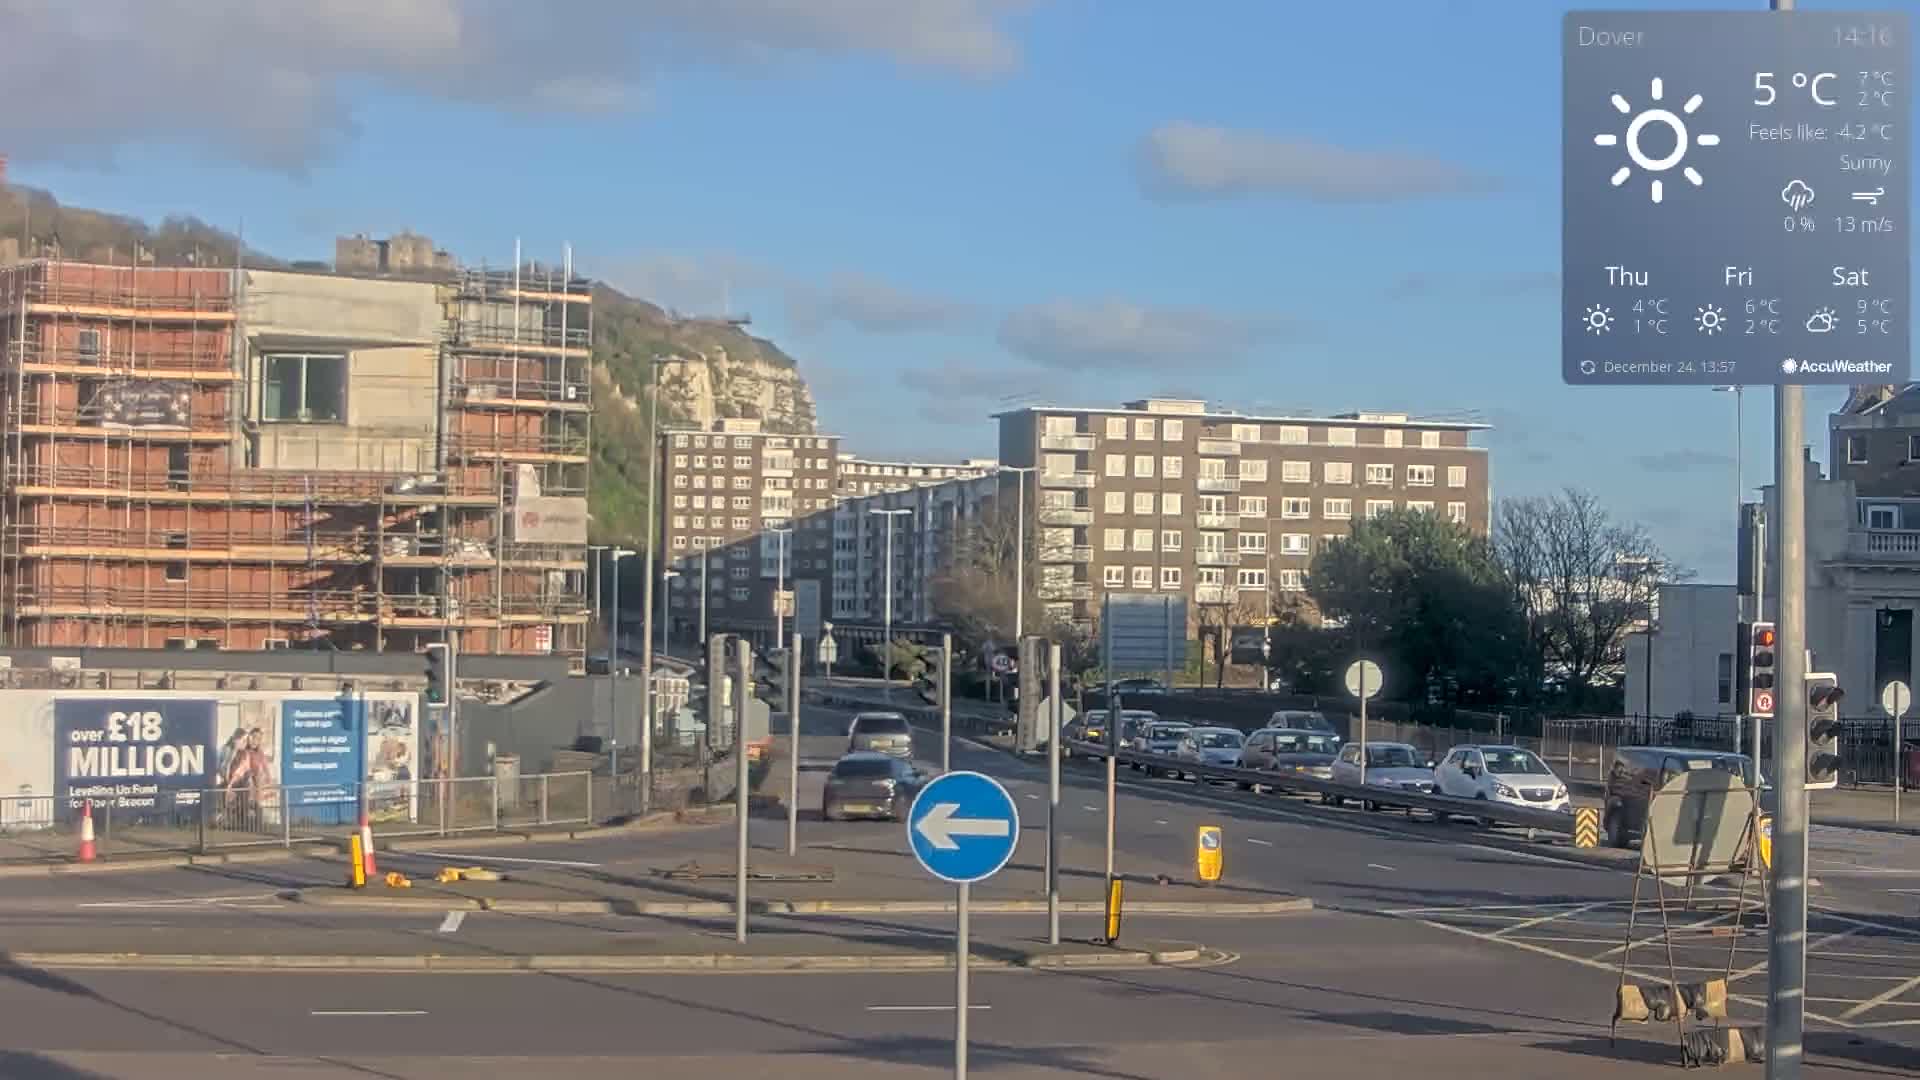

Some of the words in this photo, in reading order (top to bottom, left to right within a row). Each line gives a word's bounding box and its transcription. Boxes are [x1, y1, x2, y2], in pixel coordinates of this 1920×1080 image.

[71, 730, 104, 742] over
[109, 711, 162, 742] £18
[70, 745, 204, 776] MILLION
